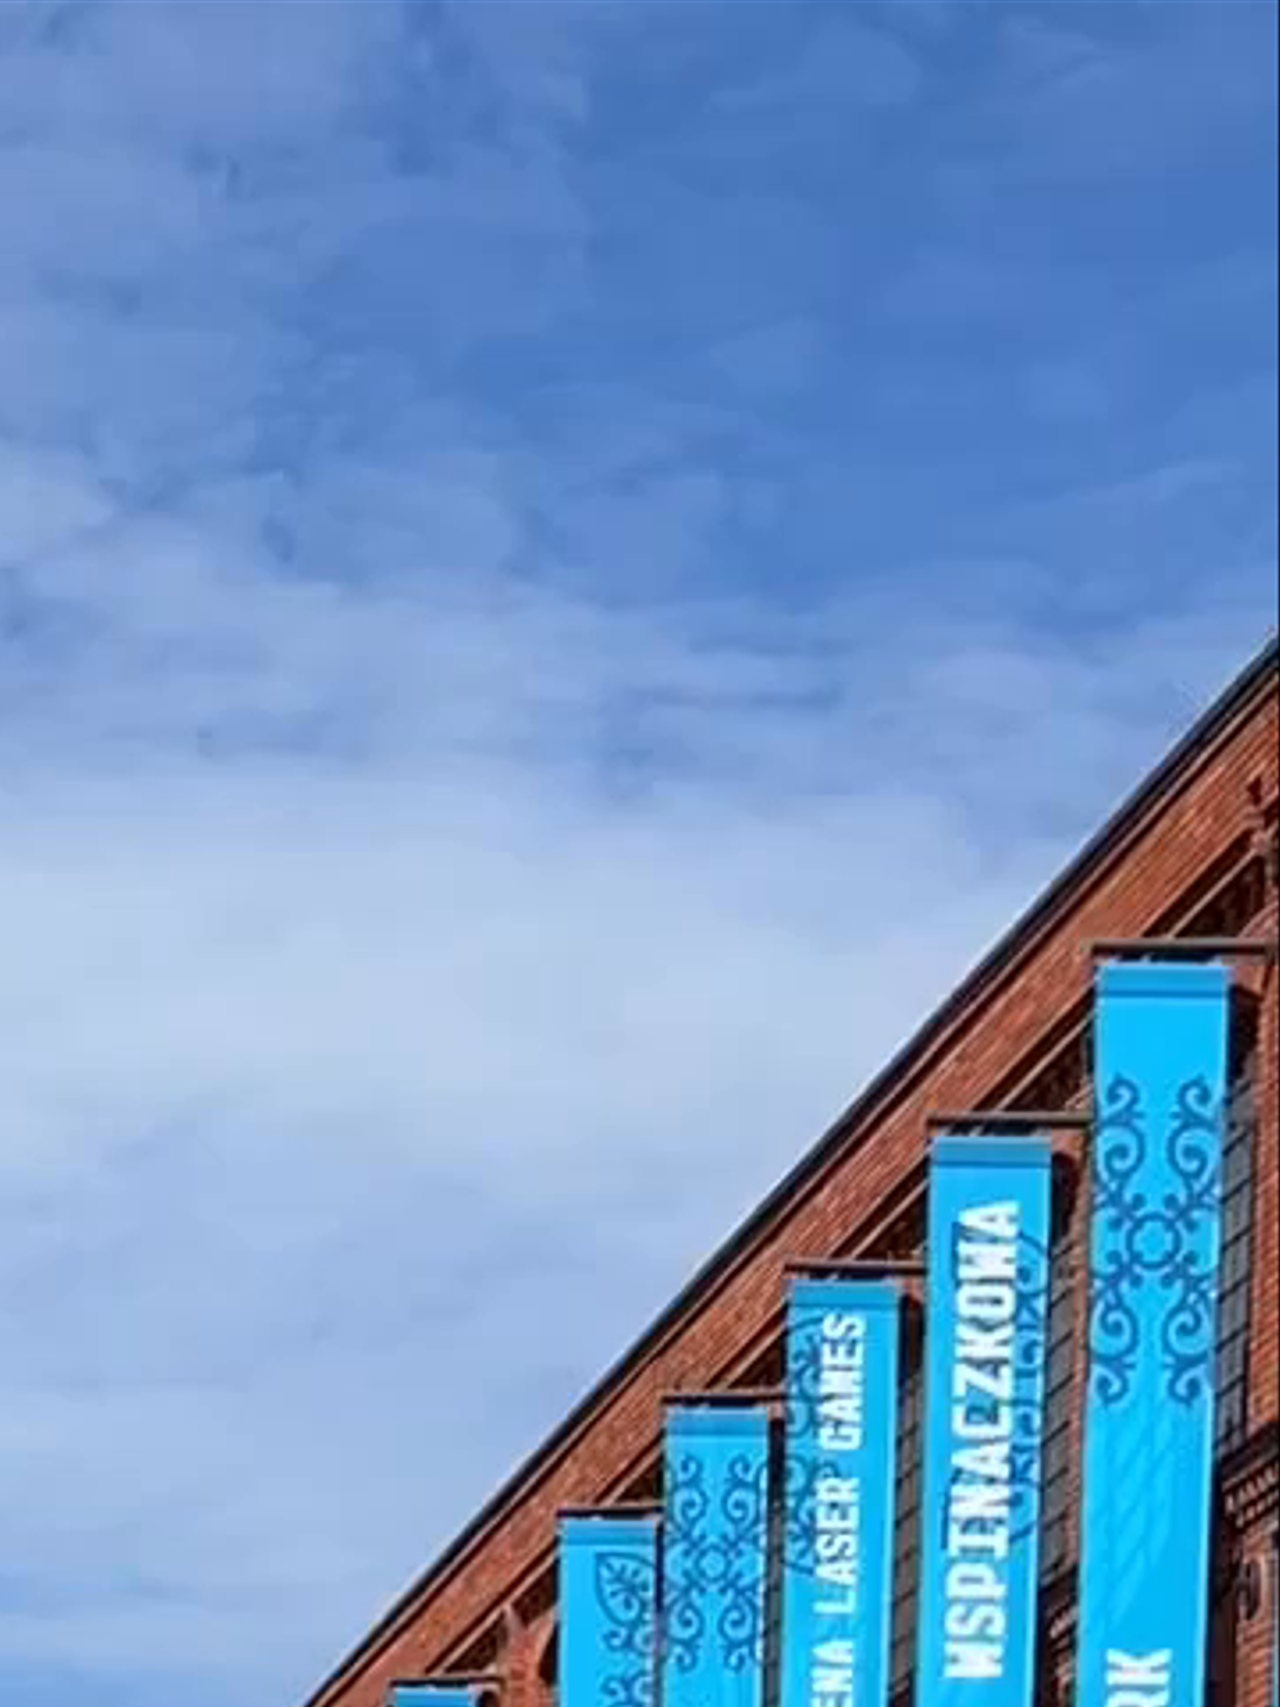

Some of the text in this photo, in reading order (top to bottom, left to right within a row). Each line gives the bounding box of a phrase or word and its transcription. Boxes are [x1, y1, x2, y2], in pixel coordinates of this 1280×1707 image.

[818, 1314, 866, 1450] GAMES
[943, 1199, 1021, 1677] WSPINACZKOWA
[814, 1476, 859, 1614] LASER
